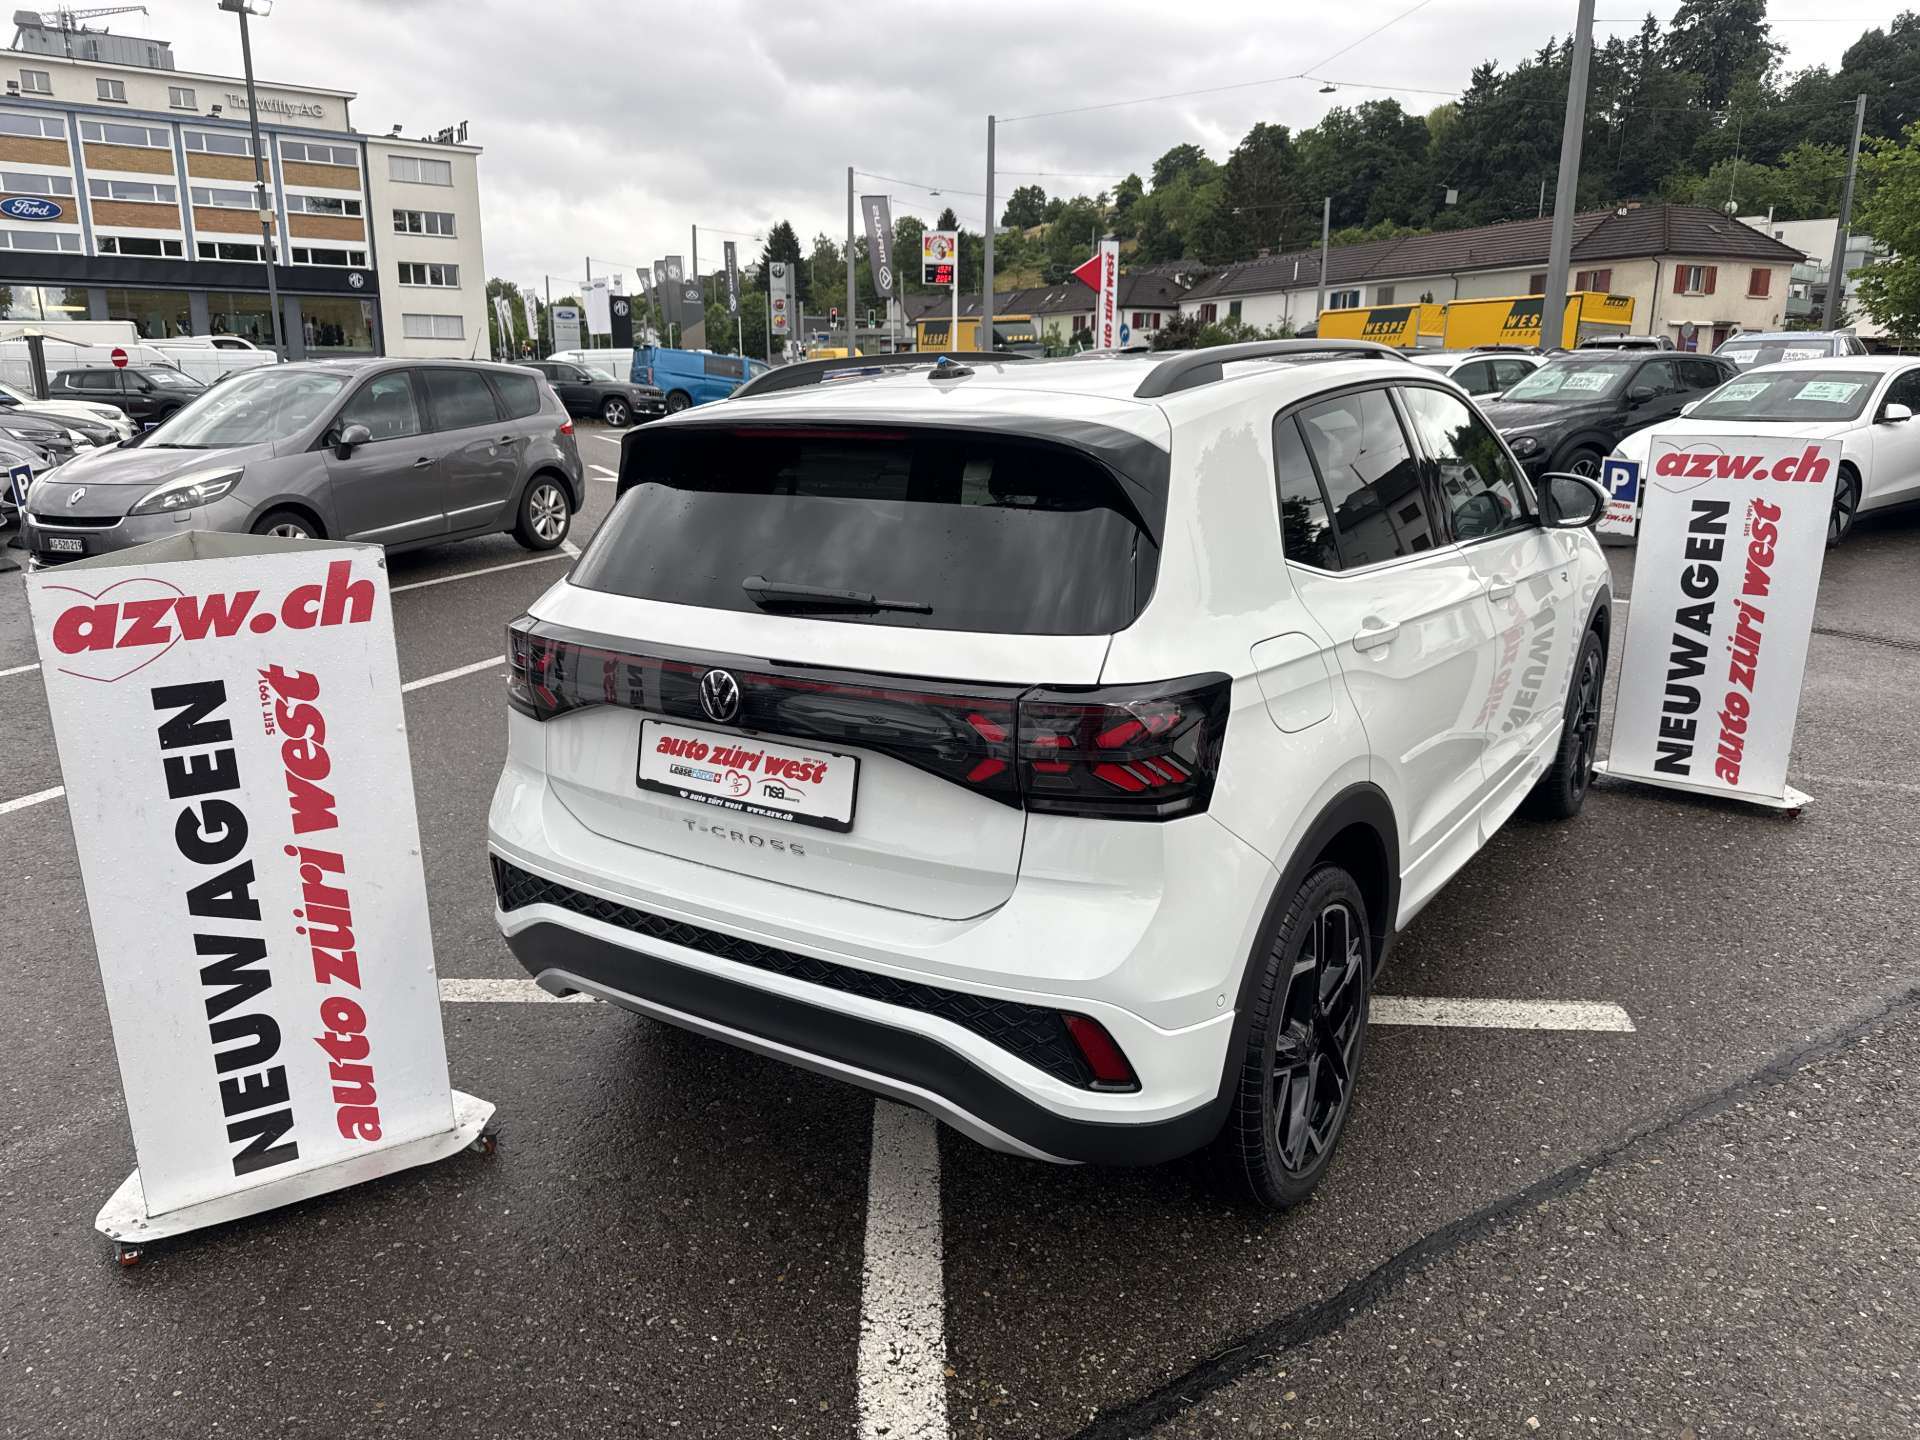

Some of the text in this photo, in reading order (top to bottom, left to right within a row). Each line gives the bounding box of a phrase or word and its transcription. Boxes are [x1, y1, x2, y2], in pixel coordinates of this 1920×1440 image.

[300, 103, 323, 118] AG
[12, 200, 49, 215] Ford
[349, 272, 364, 288] MG
[614, 301, 629, 317] MG
[1104, 252, 1115, 348] uto züri west
[1365, 320, 1406, 334] WESPE
[1507, 314, 1543, 328] WES
[923, 334, 948, 345] WESPE
[1655, 445, 1831, 483] azw.ch
[16, 474, 29, 500] P
[1610, 467, 1630, 495] P
[52, 559, 376, 655] azw.ch
[1653, 499, 1731, 776] NEUWAGEN
[1714, 497, 1783, 786] auto züri west
[258, 679, 276, 736] SEIT 1991
[656, 735, 828, 784] auto züri west
[689, 793, 706, 803] auto
[724, 801, 743, 811] west
[763, 784, 785, 800] nsa
[682, 819, 806, 857] T-CROSS
[257, 663, 383, 1142] auto züri west
[151, 680, 299, 1176] NEUWAGEN
